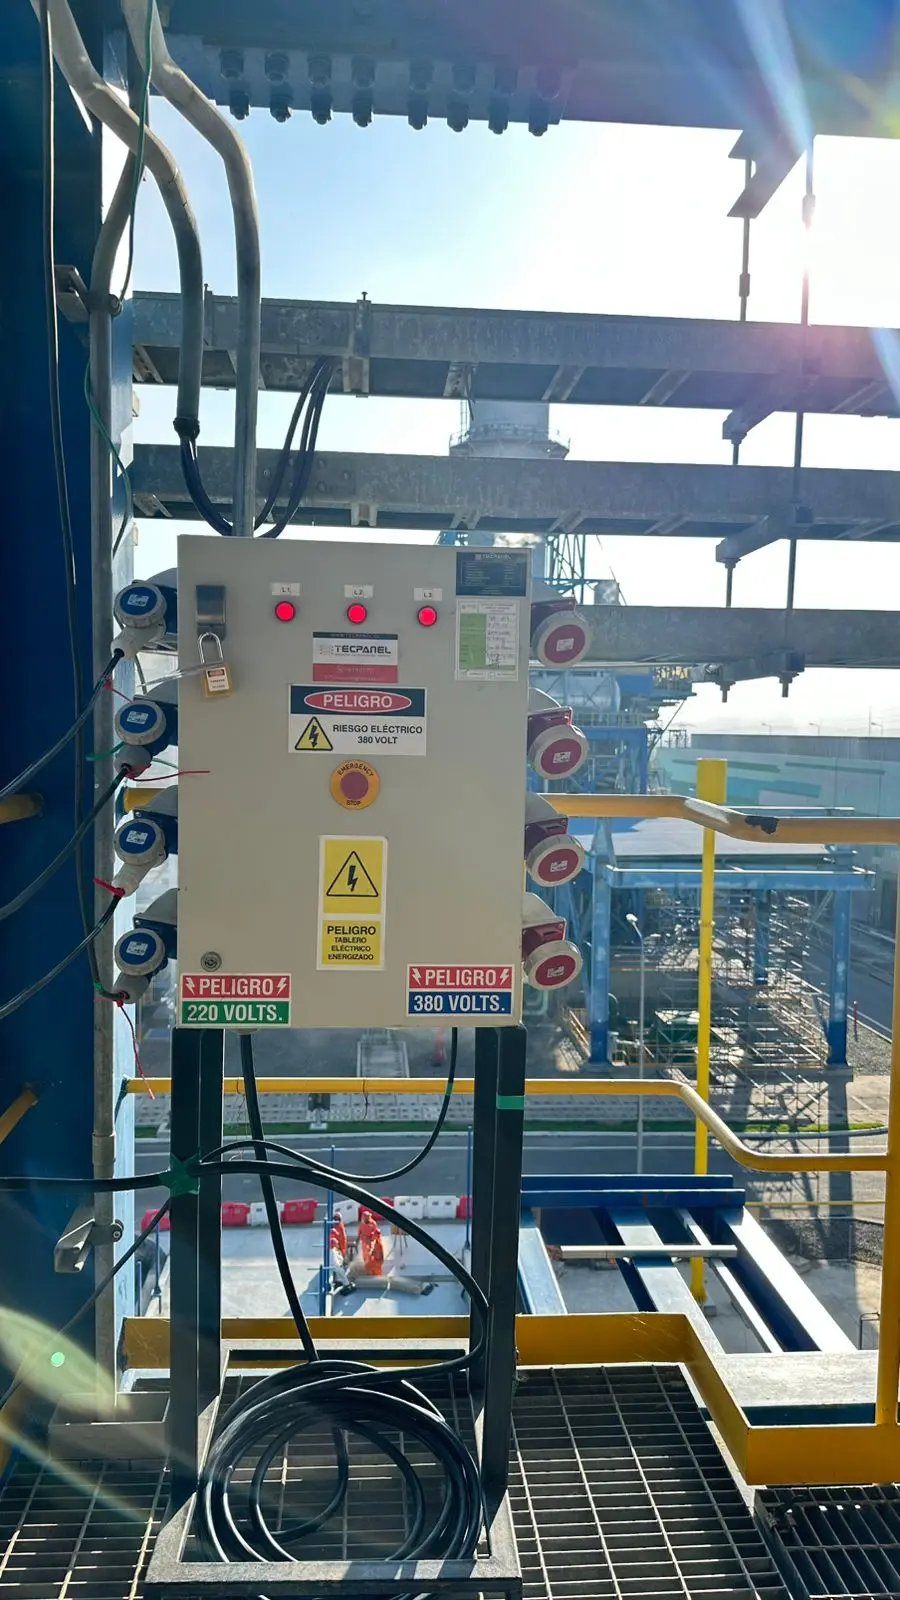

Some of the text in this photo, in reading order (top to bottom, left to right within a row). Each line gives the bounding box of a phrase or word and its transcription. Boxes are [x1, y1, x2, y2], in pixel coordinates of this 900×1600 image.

[334, 644, 391, 654] TECPANEL
[323, 694, 393, 708] PELIGRO
[332, 723, 423, 734] RIESGO ELÉCTRICO
[357, 736, 399, 744] 380 VOLT
[337, 763, 374, 777] EMERGENCY
[327, 925, 376, 935] PELIGRO
[331, 944, 371, 952] ELÉCTRICO
[425, 969, 497, 986] PELIGRO
[199, 978, 274, 995] PELIGRO
[413, 995, 505, 1011] 380 VOLTS.
[187, 1004, 283, 1021] 220 VOLTS.
